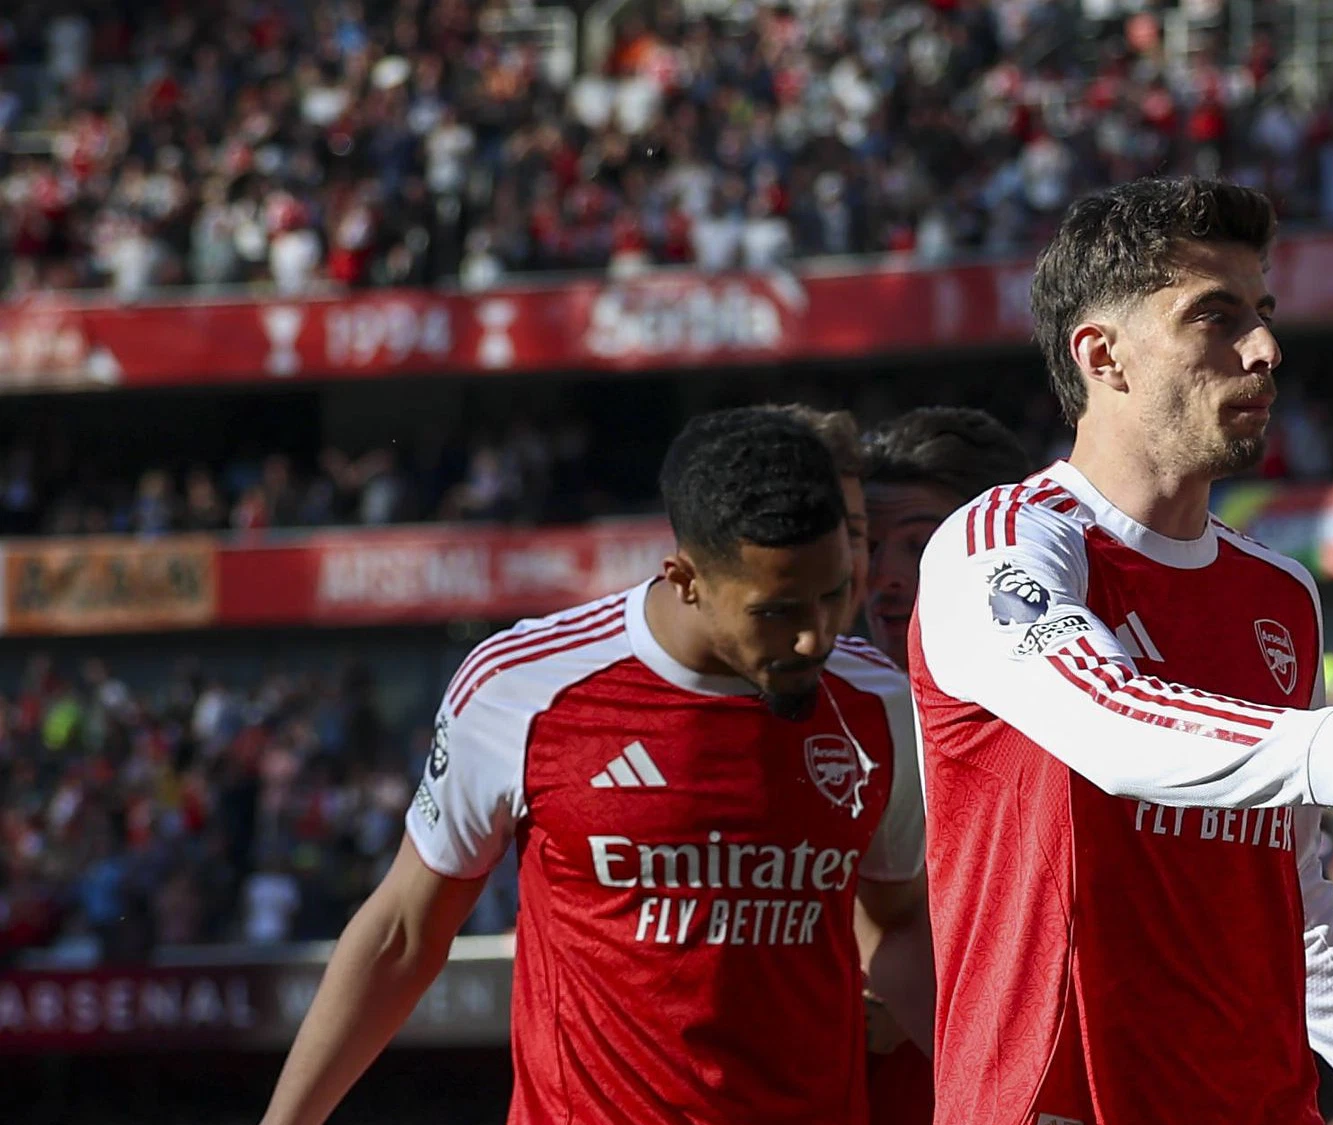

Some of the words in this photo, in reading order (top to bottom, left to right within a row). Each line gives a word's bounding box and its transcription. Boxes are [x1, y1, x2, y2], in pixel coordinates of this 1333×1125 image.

[324, 303, 452, 366] 1994
[1031, 617, 1081, 638] room
[1135, 800, 1187, 838] FLY
[1202, 805, 1294, 850] BETTER
[587, 832, 857, 892] Emirates
[636, 897, 698, 944] FLY
[706, 899, 822, 946] BETTER
